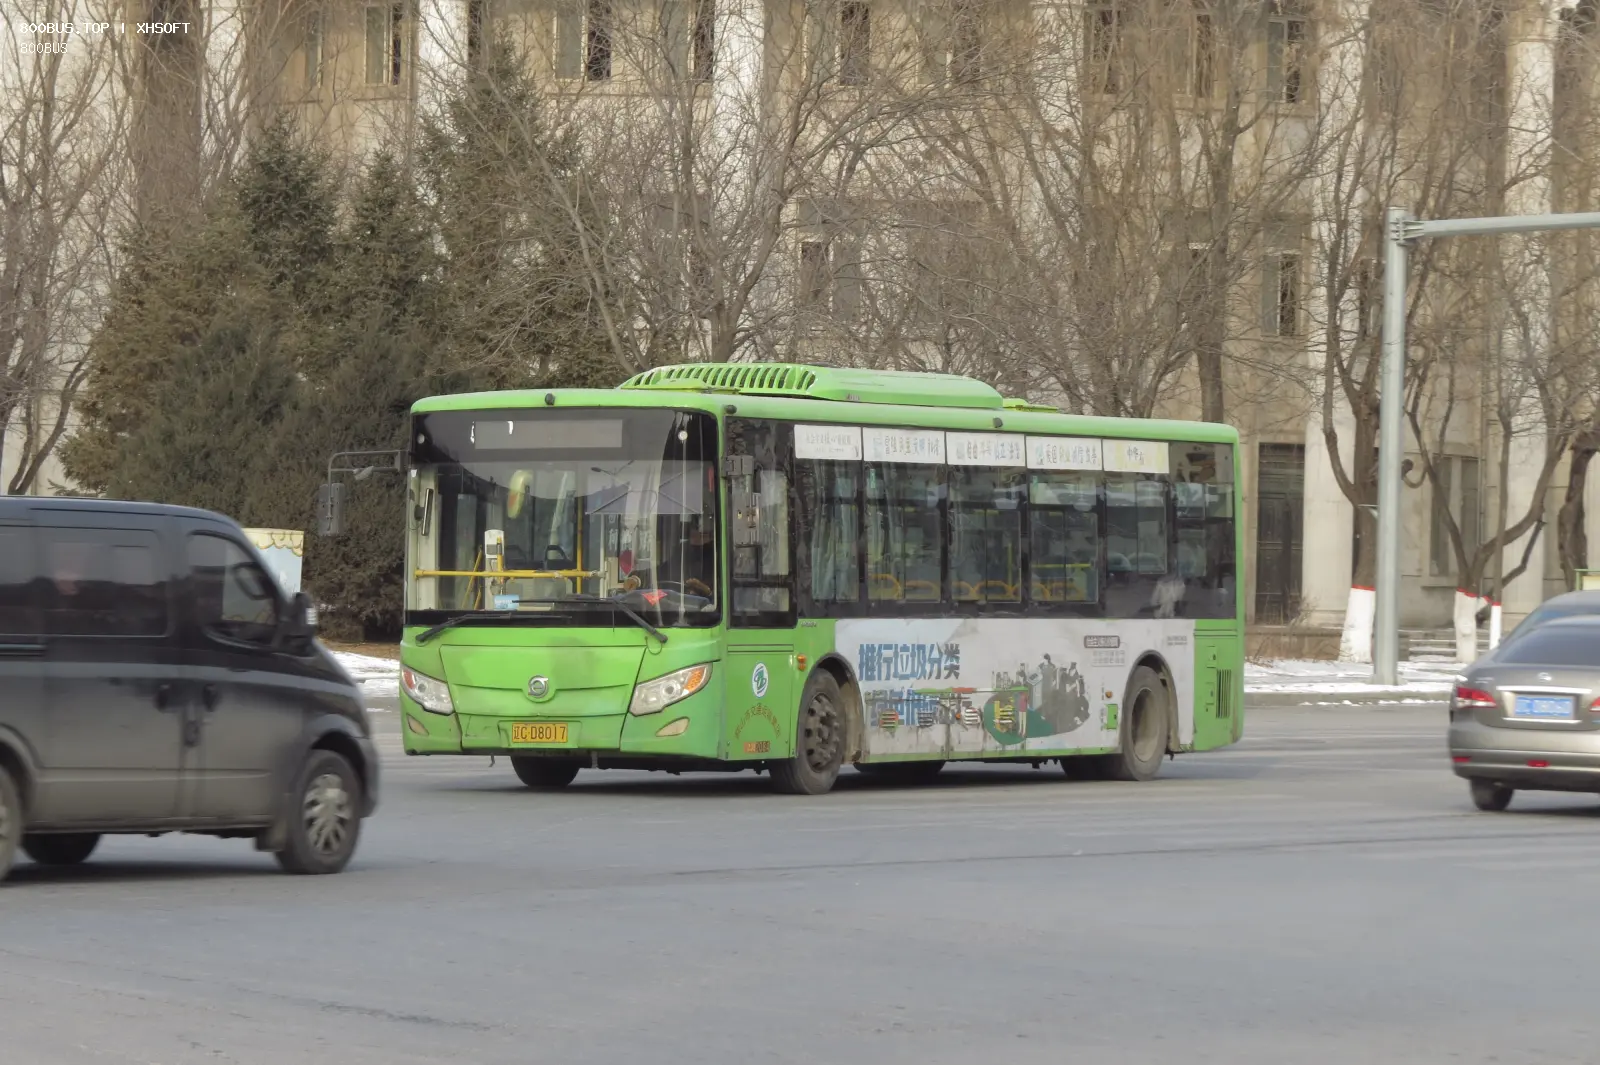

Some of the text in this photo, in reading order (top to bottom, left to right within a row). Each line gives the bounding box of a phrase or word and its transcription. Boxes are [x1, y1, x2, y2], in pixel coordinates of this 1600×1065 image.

[858, 643, 961, 681] 推行垃圾分类
